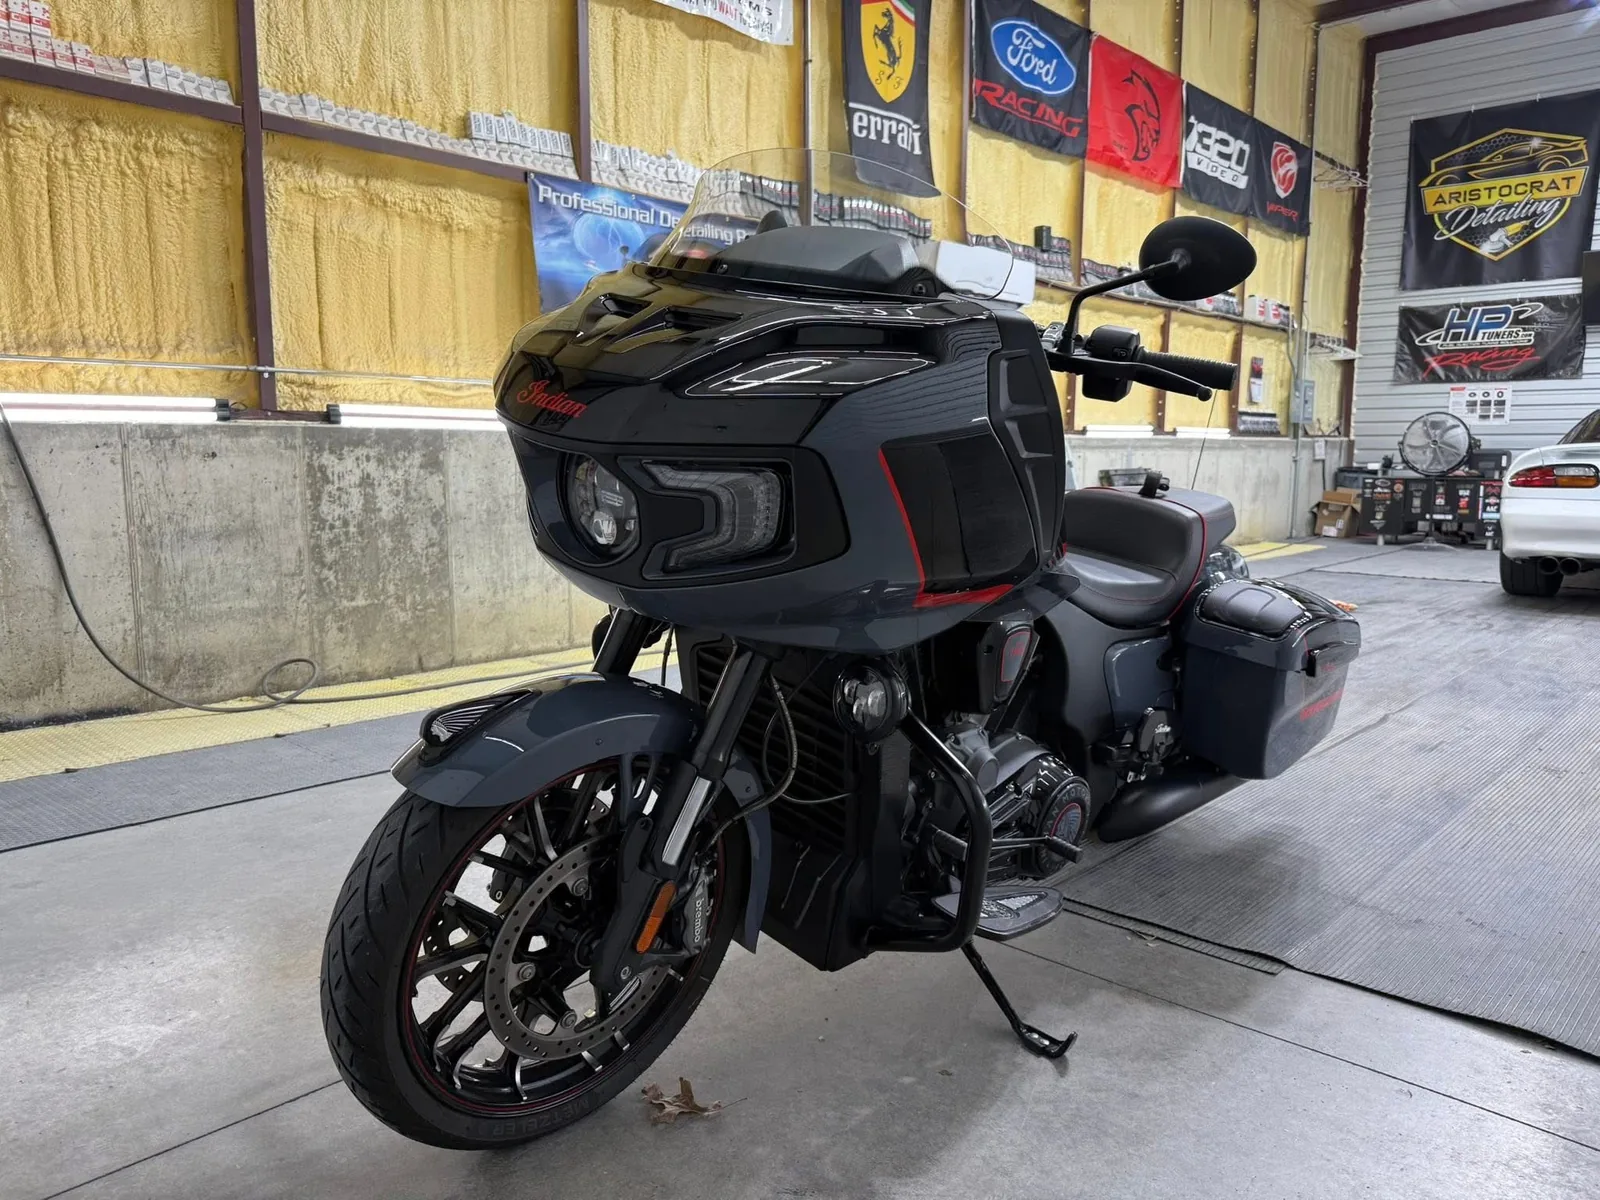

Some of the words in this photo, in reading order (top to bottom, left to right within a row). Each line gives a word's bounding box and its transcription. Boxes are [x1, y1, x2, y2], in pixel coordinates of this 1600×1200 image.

[1007, 28, 1057, 85] Ford
[975, 78, 1084, 138] RACING
[850, 103, 922, 155] errari
[1196, 157, 1240, 183] VIDEO
[538, 184, 654, 225] Professional
[1433, 176, 1576, 206] ARISTOCRAT
[1266, 201, 1299, 222] VIPER
[1434, 192, 1563, 241] Detailing
[1439, 304, 1514, 342] HP
[516, 380, 588, 418] Indian
[694, 897, 705, 944] brembo
[492, 1098, 590, 1136] METZELER
